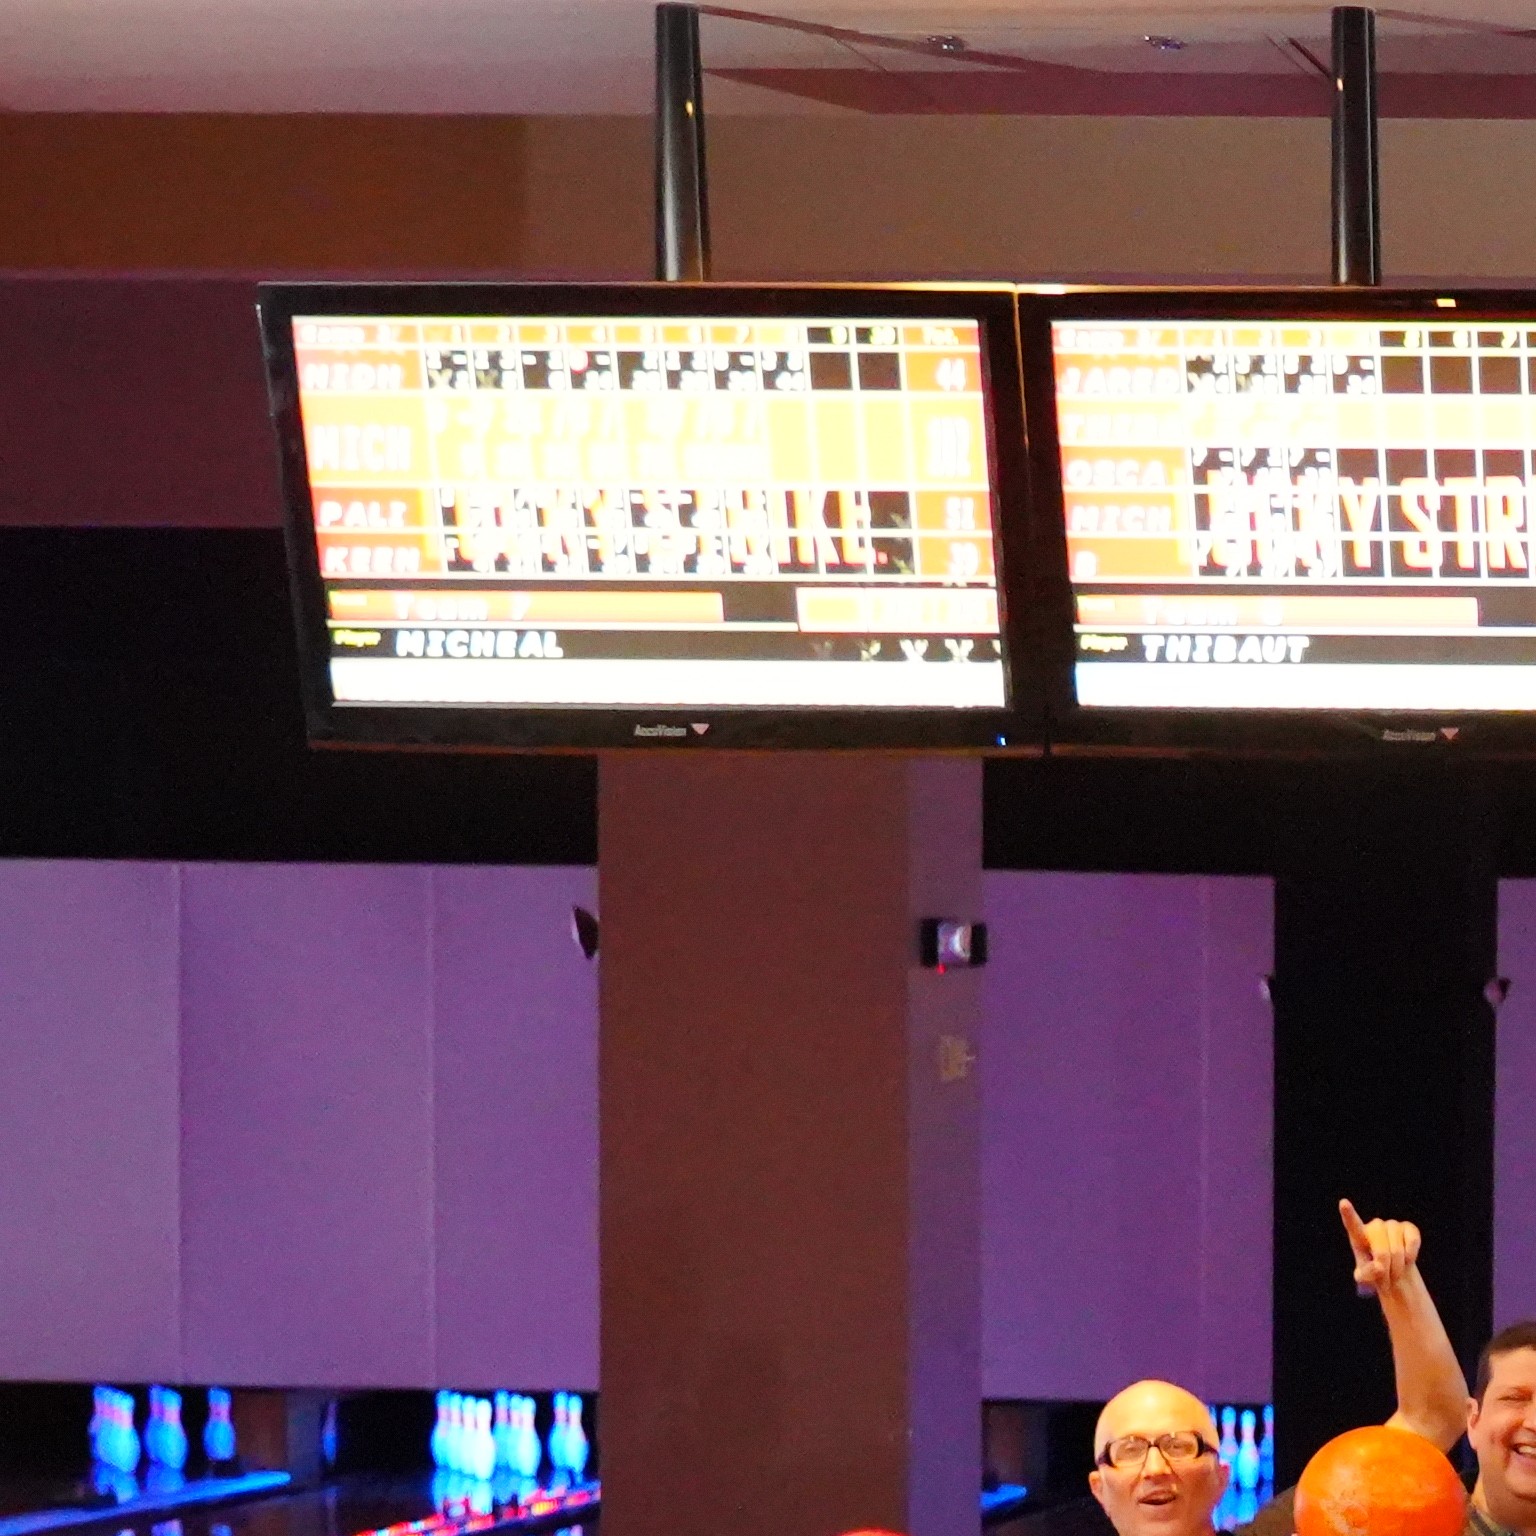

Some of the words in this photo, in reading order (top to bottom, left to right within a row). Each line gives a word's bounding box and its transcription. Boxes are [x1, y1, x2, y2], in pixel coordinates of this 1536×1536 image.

[1066, 459, 1168, 488] OSCA
[319, 501, 407, 528] PALI
[395, 629, 565, 659] MICHEAL
[1141, 634, 1310, 664] THIBAUT
